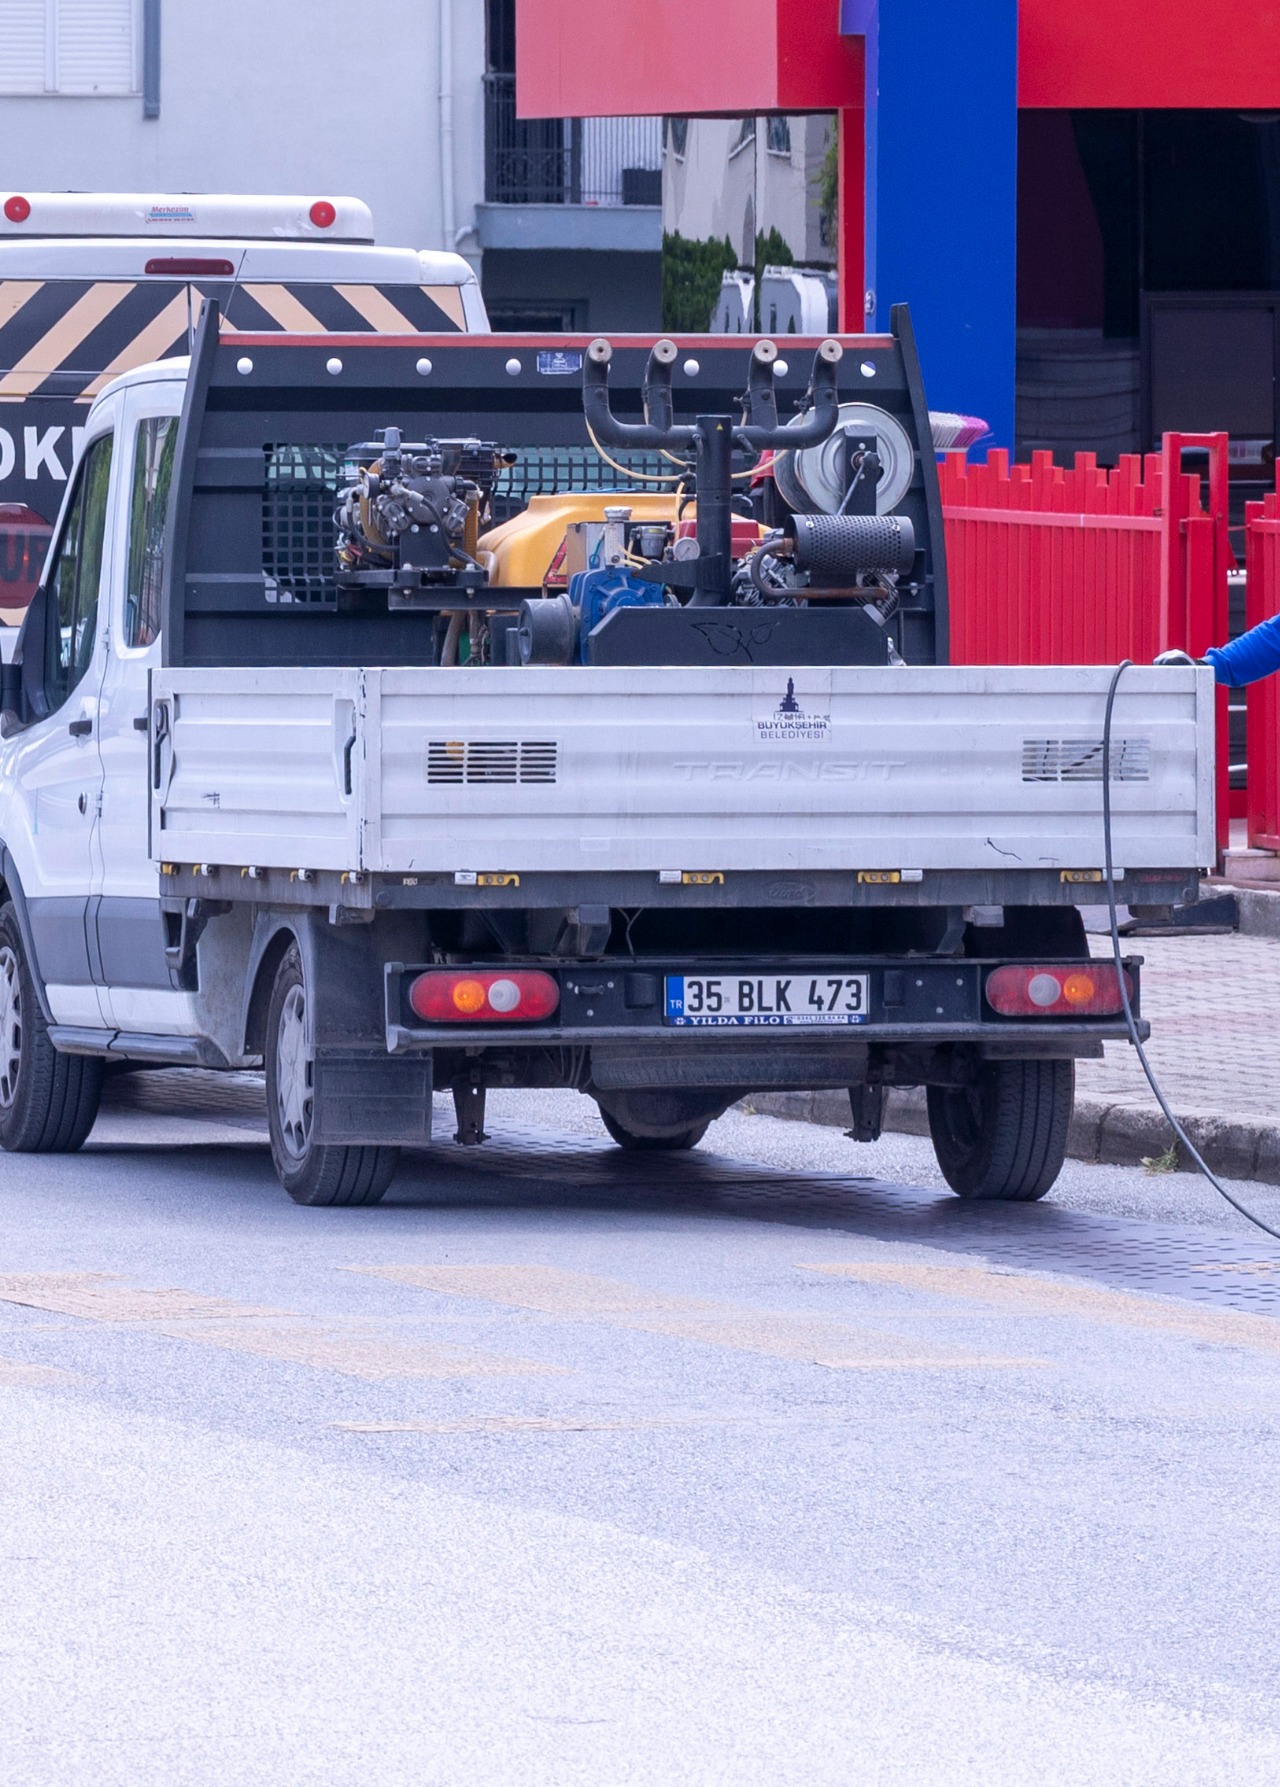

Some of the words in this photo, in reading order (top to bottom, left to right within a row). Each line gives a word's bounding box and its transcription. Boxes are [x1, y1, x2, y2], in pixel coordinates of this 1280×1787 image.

[674, 760, 907, 782] TRANSIT
[687, 980, 723, 1012] 35
[738, 980, 792, 1012] BLK
[808, 979, 862, 1012] 473
[669, 999, 683, 1009] TR
[690, 1016, 739, 1025] YILDA
